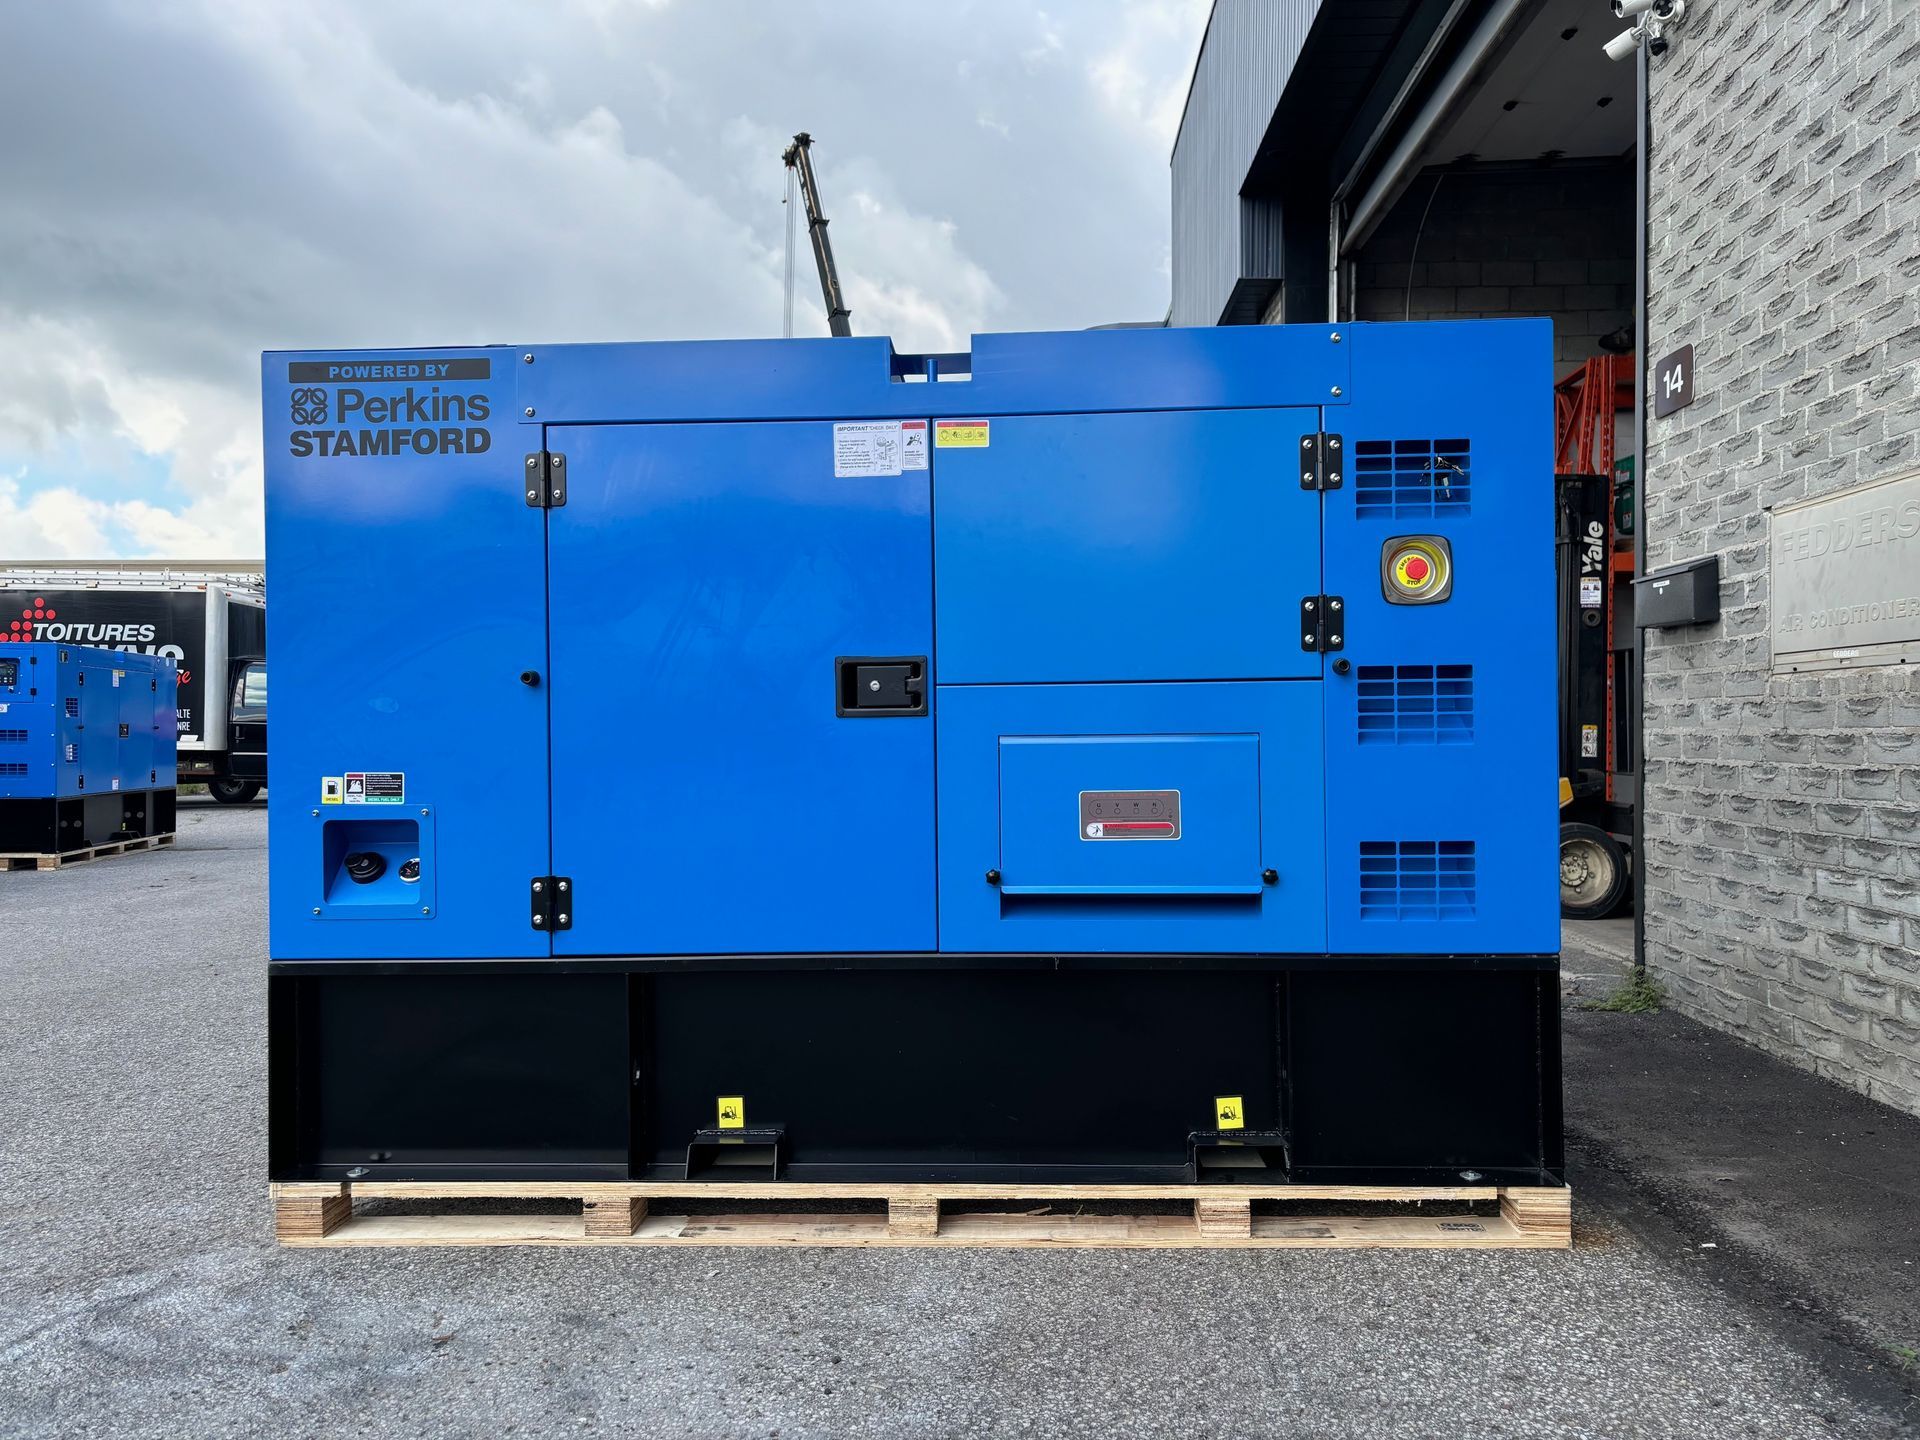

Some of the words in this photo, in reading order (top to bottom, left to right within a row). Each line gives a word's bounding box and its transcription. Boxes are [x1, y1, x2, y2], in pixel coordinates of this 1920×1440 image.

[328, 364, 420, 379] POWERED
[425, 363, 450, 377] BY
[1662, 363, 1684, 399] 14
[337, 387, 490, 424] Perkins
[290, 427, 491, 458] STAMFORD
[1776, 498, 1920, 565] FEDDERS
[1581, 520, 1604, 577] Yale
[33, 623, 156, 642] TOITURES
[1777, 613, 1804, 634] AIR
[176, 721, 191, 731] NRE
